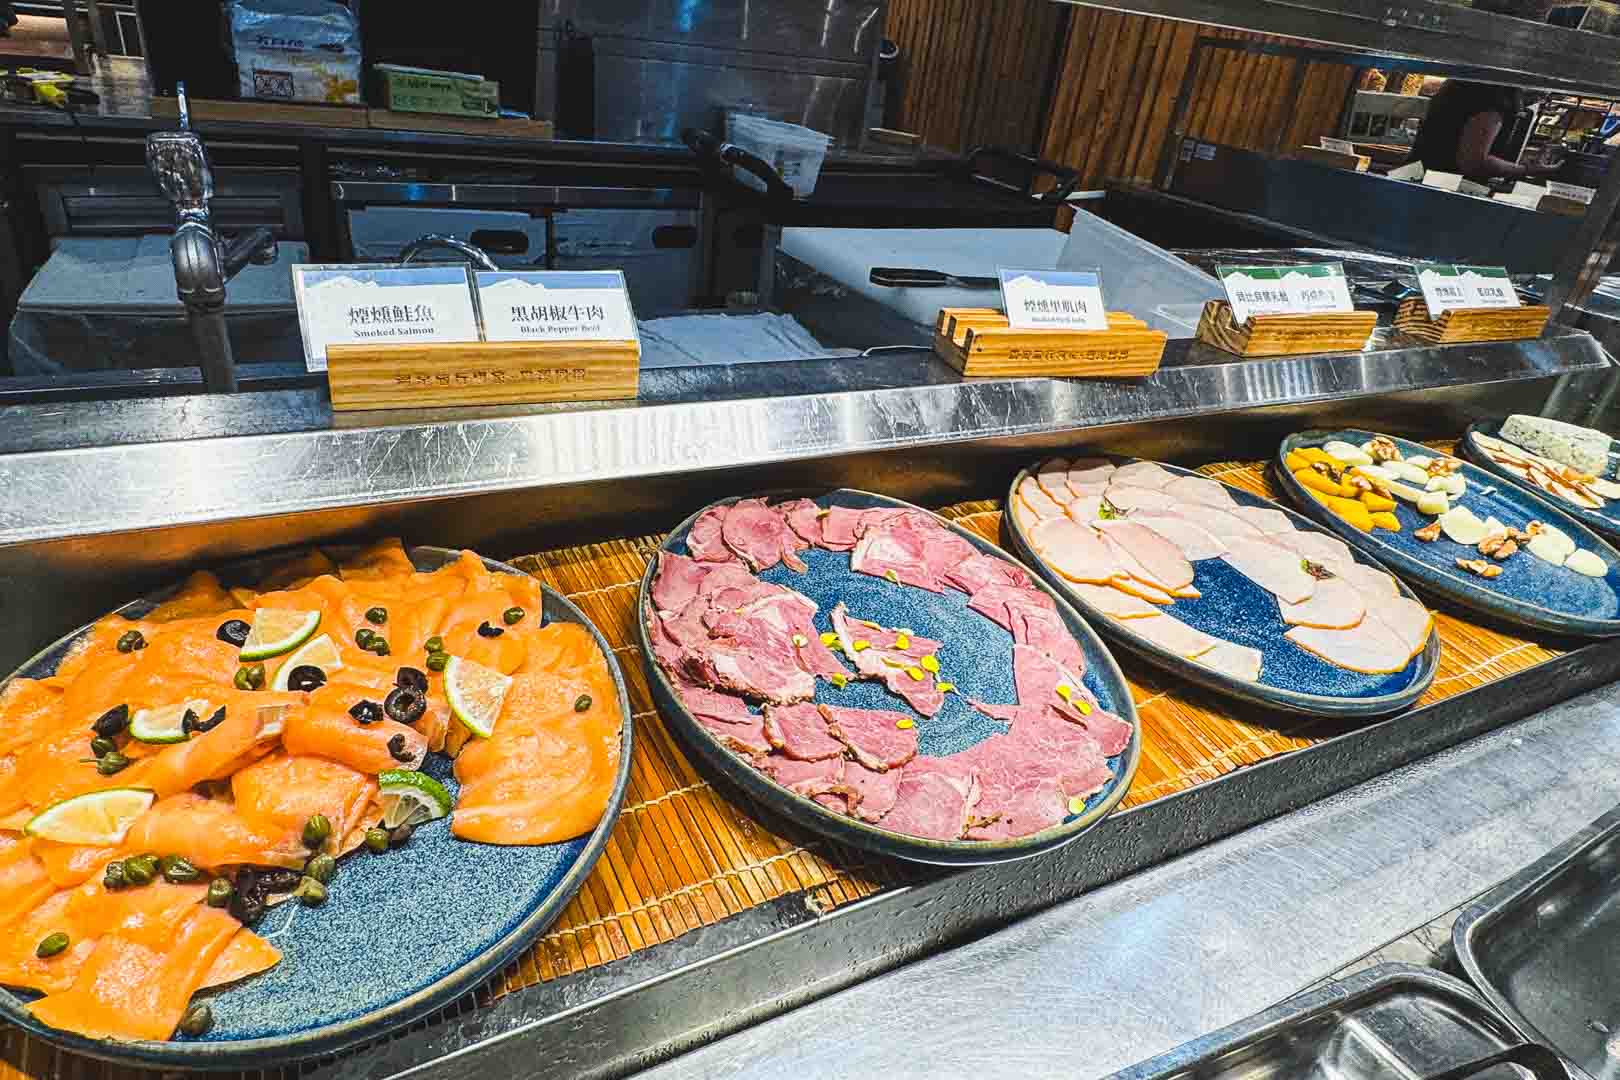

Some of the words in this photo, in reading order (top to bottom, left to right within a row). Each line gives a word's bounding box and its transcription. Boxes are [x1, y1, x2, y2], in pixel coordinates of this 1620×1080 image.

[349, 304, 434, 324] 煙燻鮭魚
[353, 328, 395, 337] Smoked
[397, 327, 434, 336] Salmon
